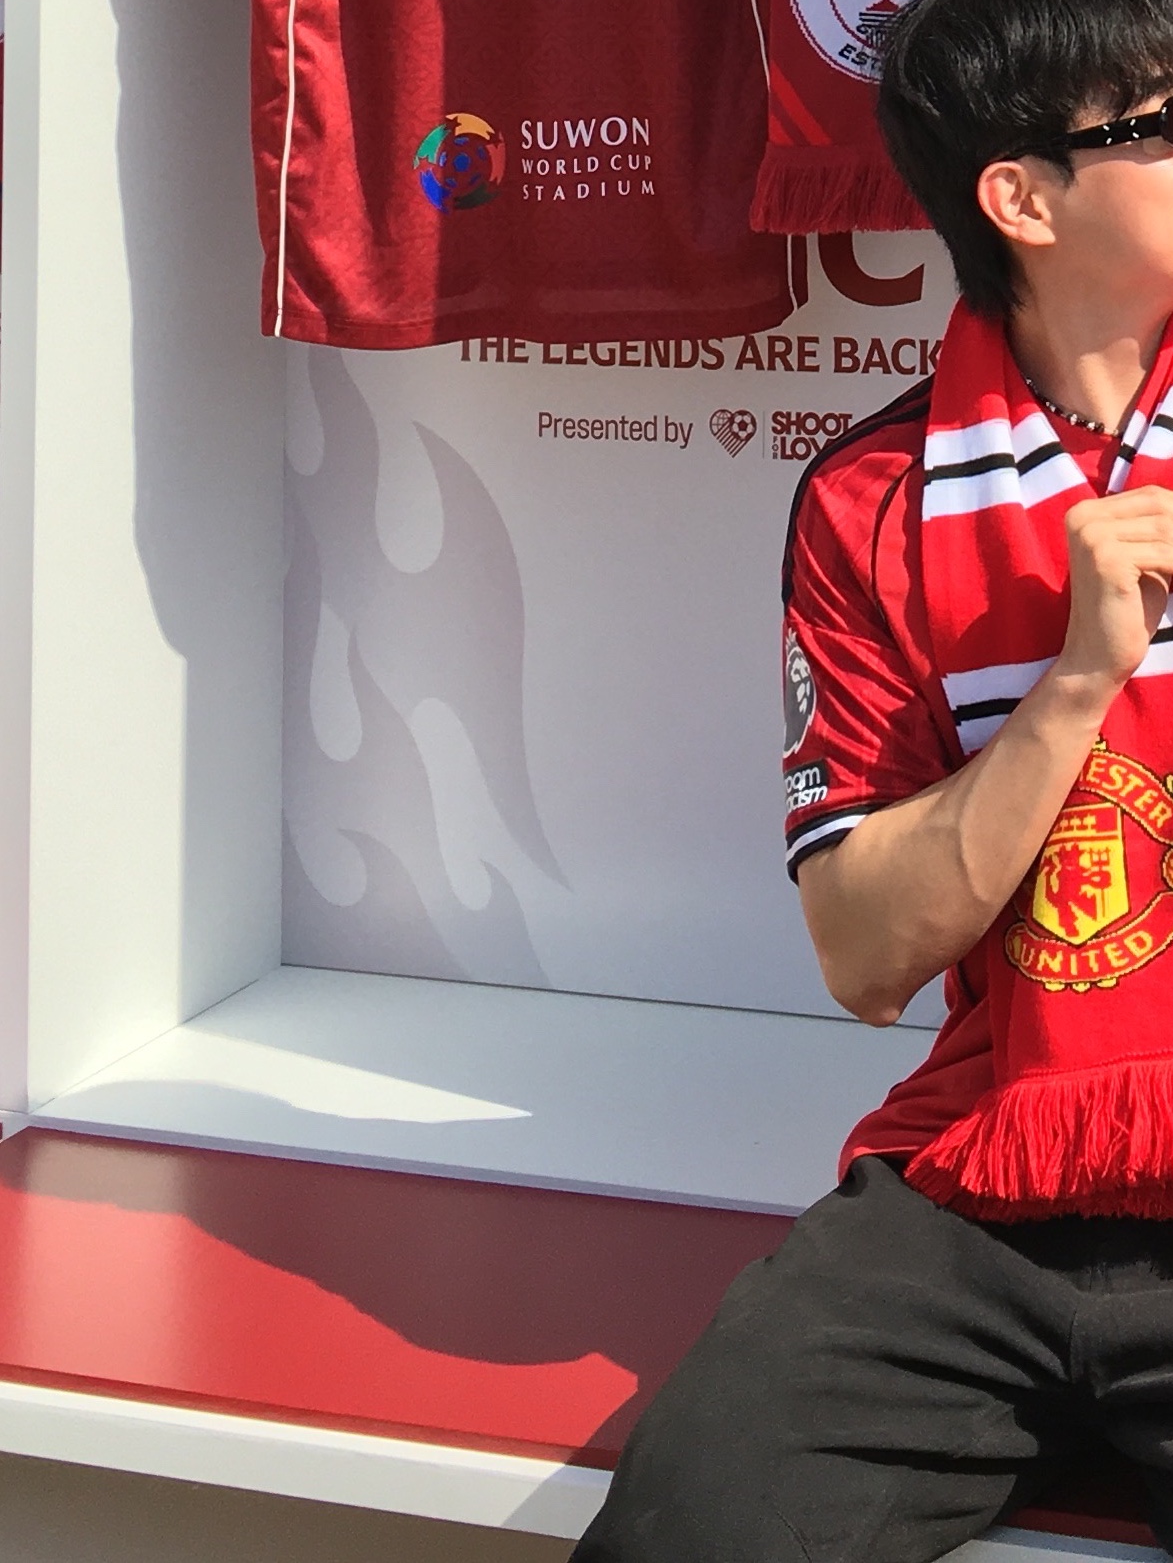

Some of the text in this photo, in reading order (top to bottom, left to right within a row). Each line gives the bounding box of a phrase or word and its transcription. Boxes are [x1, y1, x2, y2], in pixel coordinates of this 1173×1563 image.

[521, 116, 650, 150] SUWON
[521, 154, 652, 175] WORLD CUP
[522, 180, 655, 201] STADIUM
[461, 335, 943, 375] THE LEGENDS ARE BACK
[538, 412, 694, 449] Presented by
[771, 411, 853, 436] SHOOT
[780, 436, 835, 461] LOV
[1083, 757, 1173, 829] ESTER
[1020, 930, 1154, 976] UNITED
